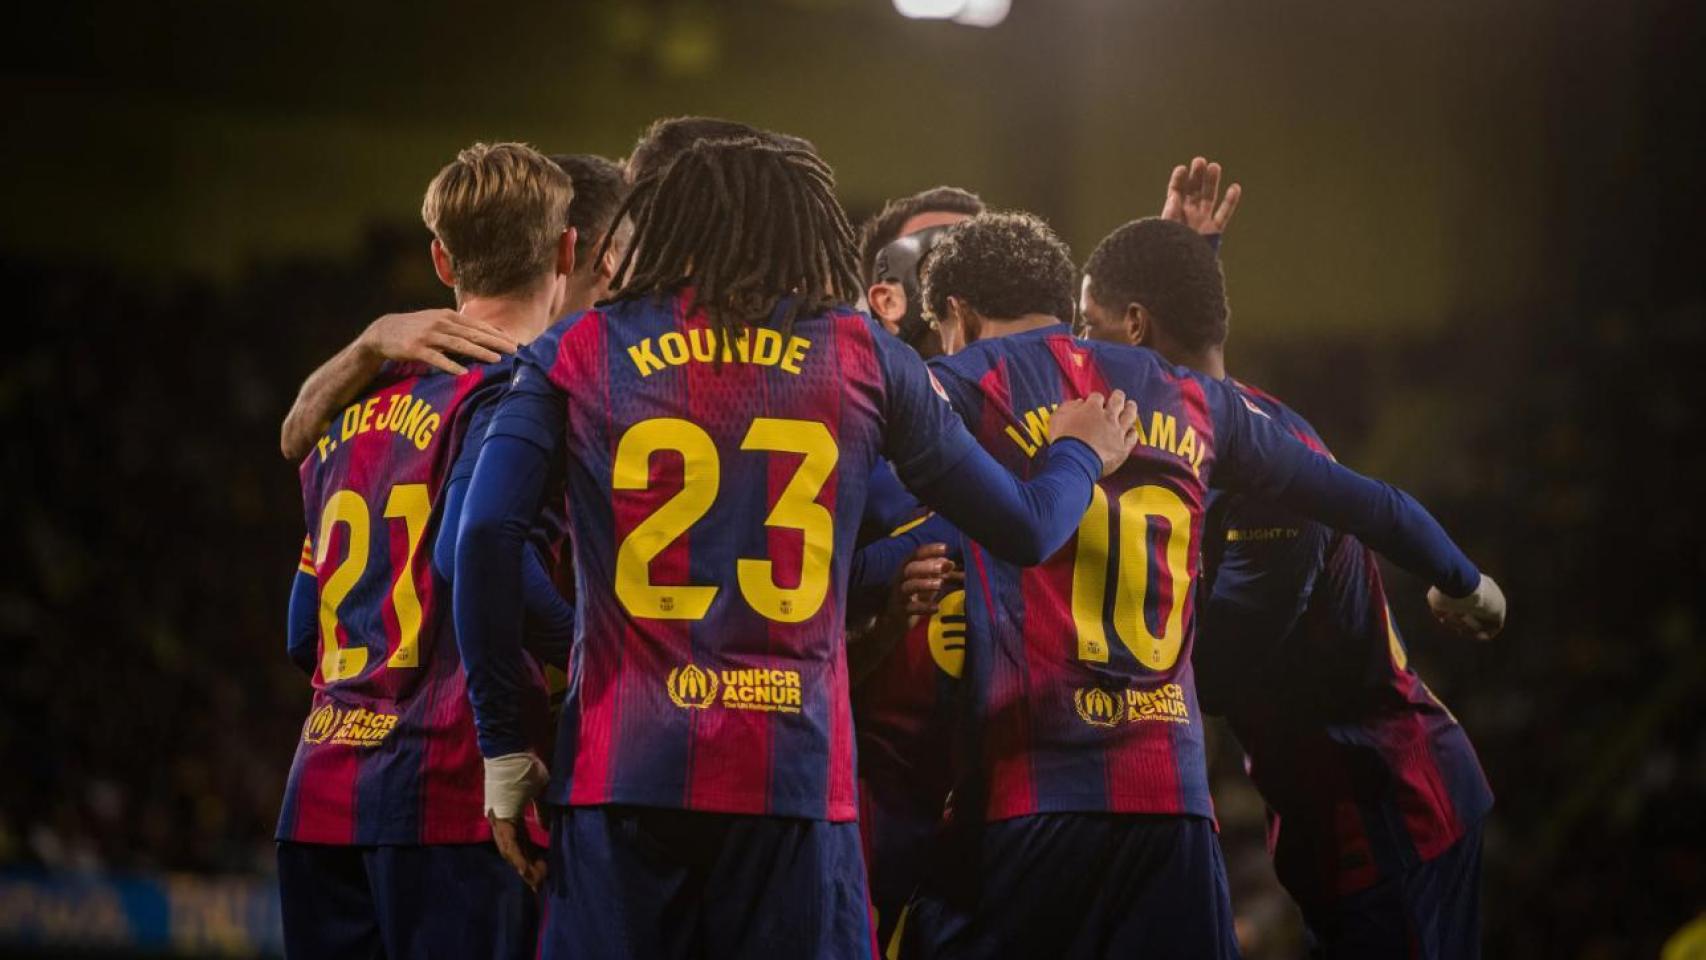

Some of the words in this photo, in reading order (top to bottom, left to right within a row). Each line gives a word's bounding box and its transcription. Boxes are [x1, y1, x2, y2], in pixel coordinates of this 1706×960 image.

[627, 327, 811, 378] KOUNDE
[341, 397, 381, 443] DE
[374, 394, 441, 450] JONG
[612, 417, 839, 624] 23
[314, 483, 433, 684] 21
[1071, 483, 1192, 672] 10
[722, 669, 800, 688] UNHCR
[722, 685, 801, 706] ACNUR
